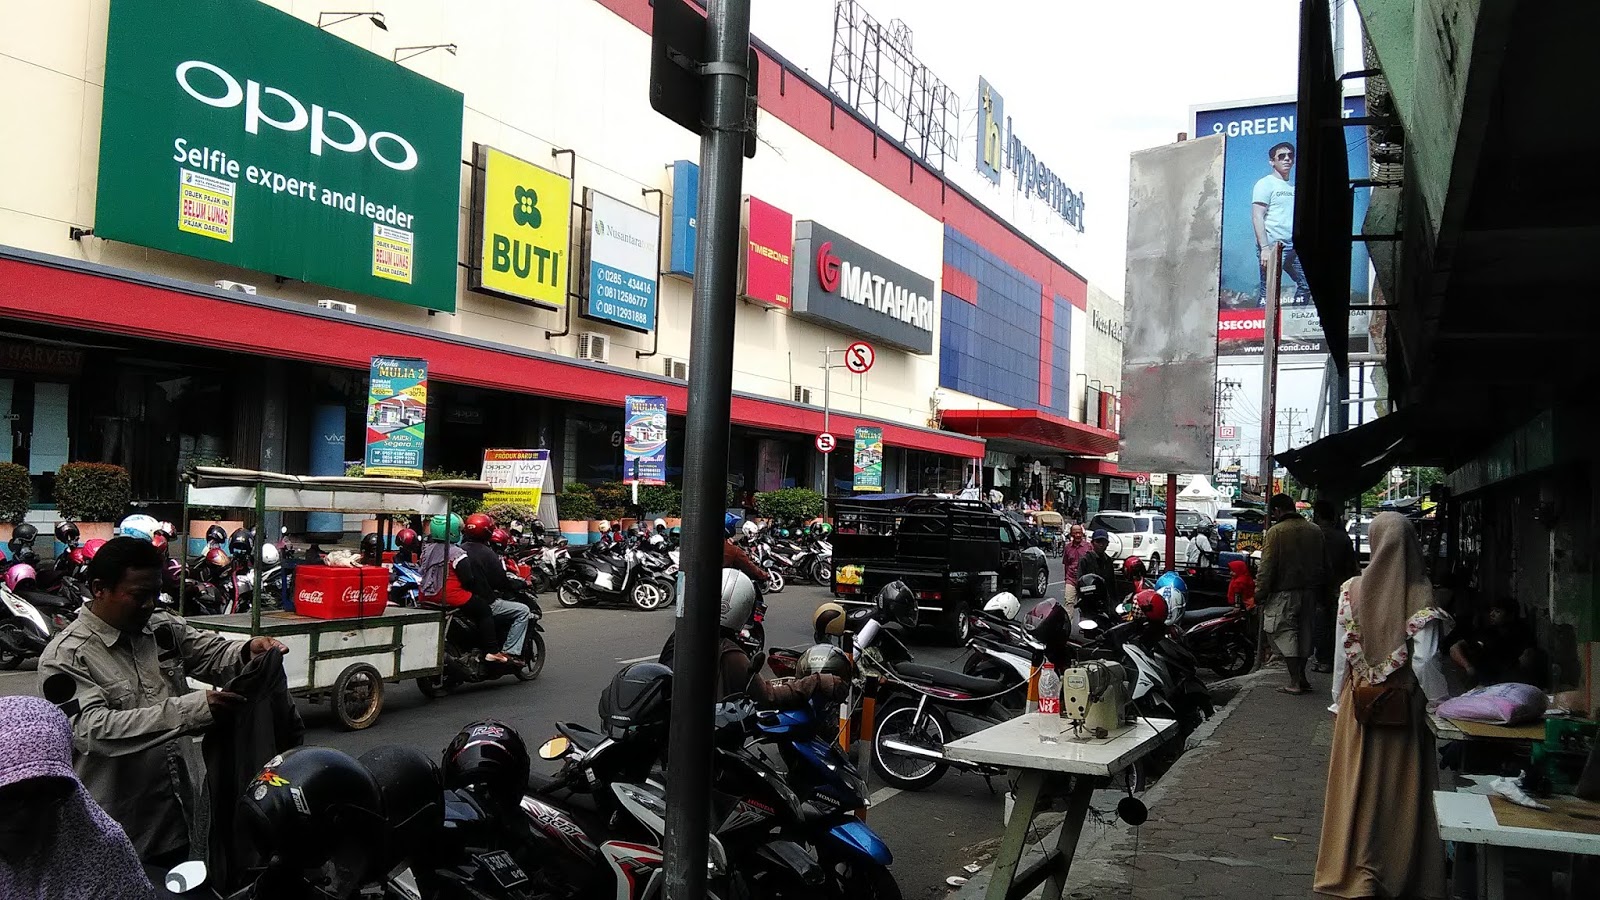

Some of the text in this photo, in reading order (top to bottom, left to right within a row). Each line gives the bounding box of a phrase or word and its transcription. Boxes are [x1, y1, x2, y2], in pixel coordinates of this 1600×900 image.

[175, 60, 418, 171] oppo
[173, 137, 414, 229] Selfie expert and leader
[1006, 115, 1085, 234] hypermart
[185, 190, 202, 199] OBJEK
[204, 195, 220, 204] PAJAK
[183, 199, 228, 226] BELUM LUNAS
[184, 219, 228, 235] PAJAK DAERAH
[492, 233, 559, 288] BUTI
[750, 241, 789, 265] TIMEZONE
[605, 270, 622, 285] 0285
[628, 278, 652, 294] 434416
[605, 286, 648, 308] 08112586777
[841, 261, 933, 332] MATAHARI
[604, 303, 647, 324] 08112931888
[379, 366, 425, 378] MULIA 2
[299, 589, 324, 603] Coca-Cola
[748, 798, 775, 813] HONDA
[815, 792, 840, 806] HONDA
